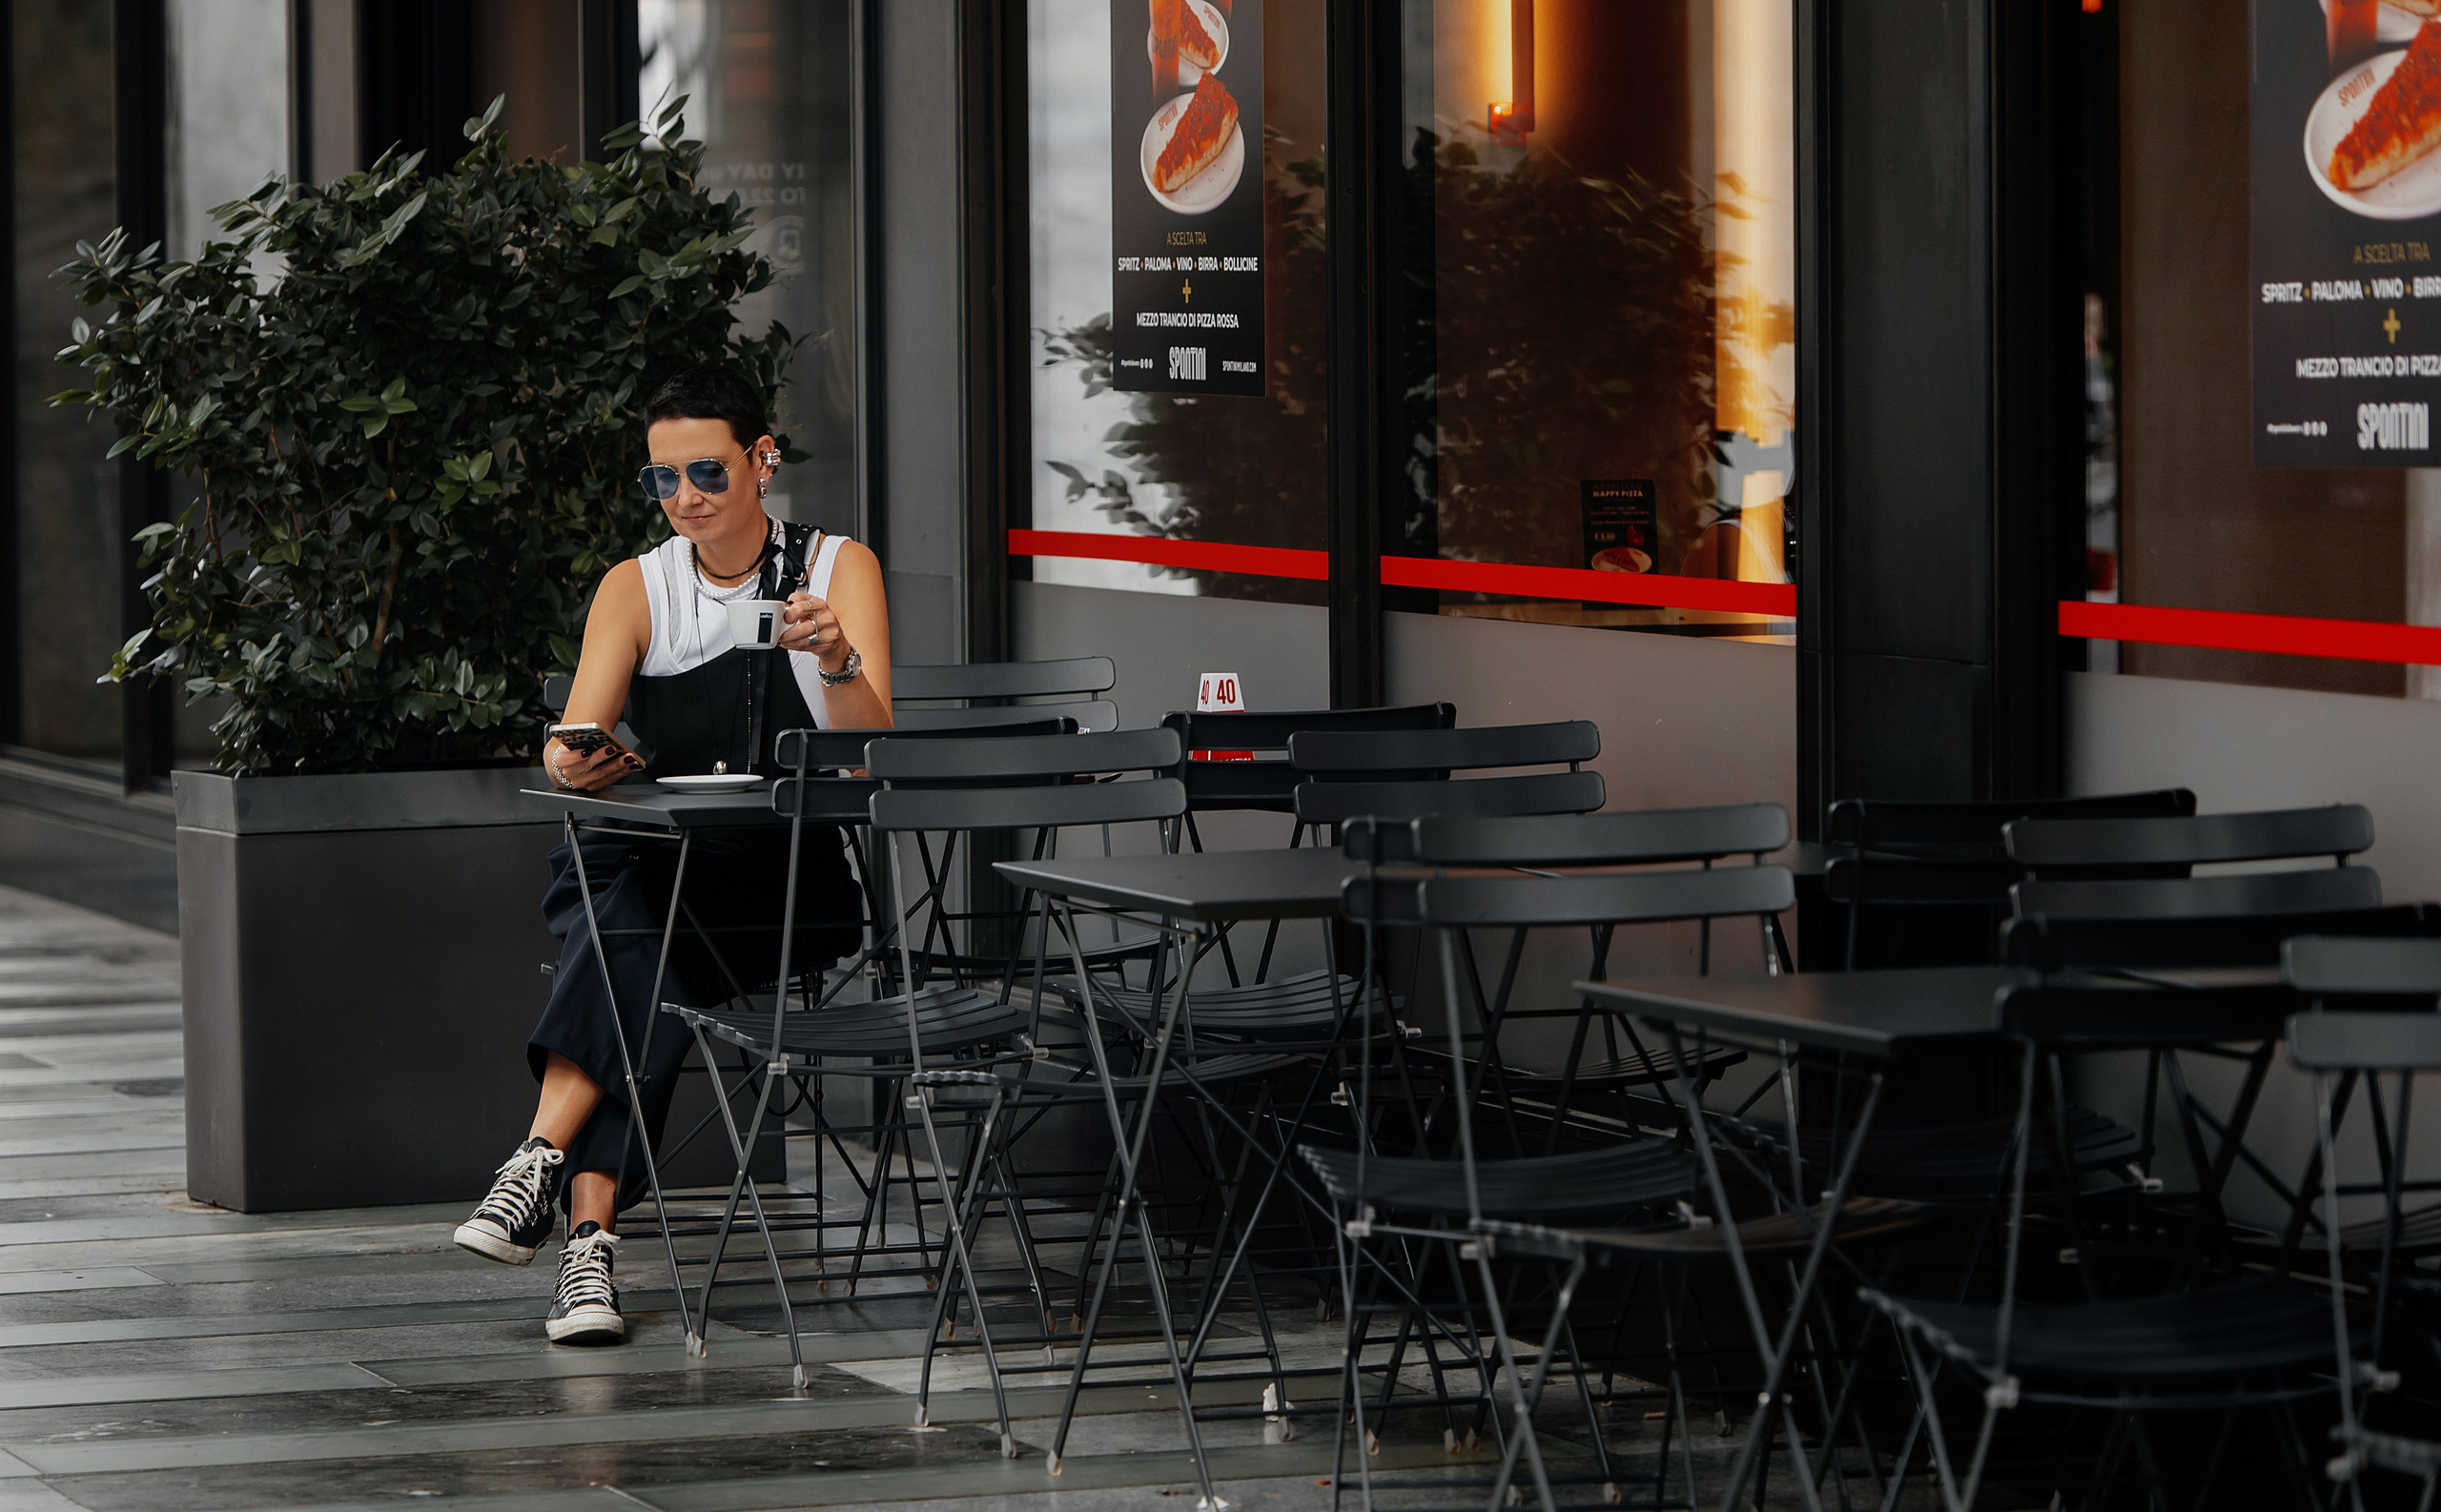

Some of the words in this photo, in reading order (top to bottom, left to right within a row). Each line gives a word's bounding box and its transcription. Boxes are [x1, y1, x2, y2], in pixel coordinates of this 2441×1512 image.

[2338, 66, 2376, 107] SPONTINI
[1158, 103, 1179, 132] SPONTINI
[1166, 232, 1172, 245] A
[1172, 231, 1194, 246] SCELTA
[1194, 231, 1207, 245] TRA
[1118, 256, 1140, 272] SPRITZ
[1144, 256, 1172, 271] PALOMA
[1176, 256, 1193, 272] VINO
[1198, 256, 1219, 272] BIRRA
[1223, 256, 1259, 272] BOLLICINE
[2353, 245, 2364, 264] A
[2364, 243, 2406, 264] SCELTA
[2407, 241, 2431, 262] TRA
[2261, 281, 2304, 304] SPRITZ
[2311, 278, 2364, 302] PALOMA
[2370, 276, 2405, 300] VINO
[1136, 312, 1159, 327] MEZZO
[1159, 312, 1188, 328] TRANCIO
[1188, 313, 1196, 328] DI
[1196, 313, 1216, 328] PIZZA
[1216, 313, 1240, 329] ROSSA
[1168, 346, 1207, 381] SPONTINI
[2295, 357, 2338, 379] MEZZO
[2338, 355, 2394, 378] TRANCIO
[2394, 355, 2410, 378] DI
[2410, 354, 2441, 378] PIZZ
[2356, 401, 2430, 450] SPONTINI
[1200, 679, 1210, 705] 40
[1216, 678, 1237, 705] 40
